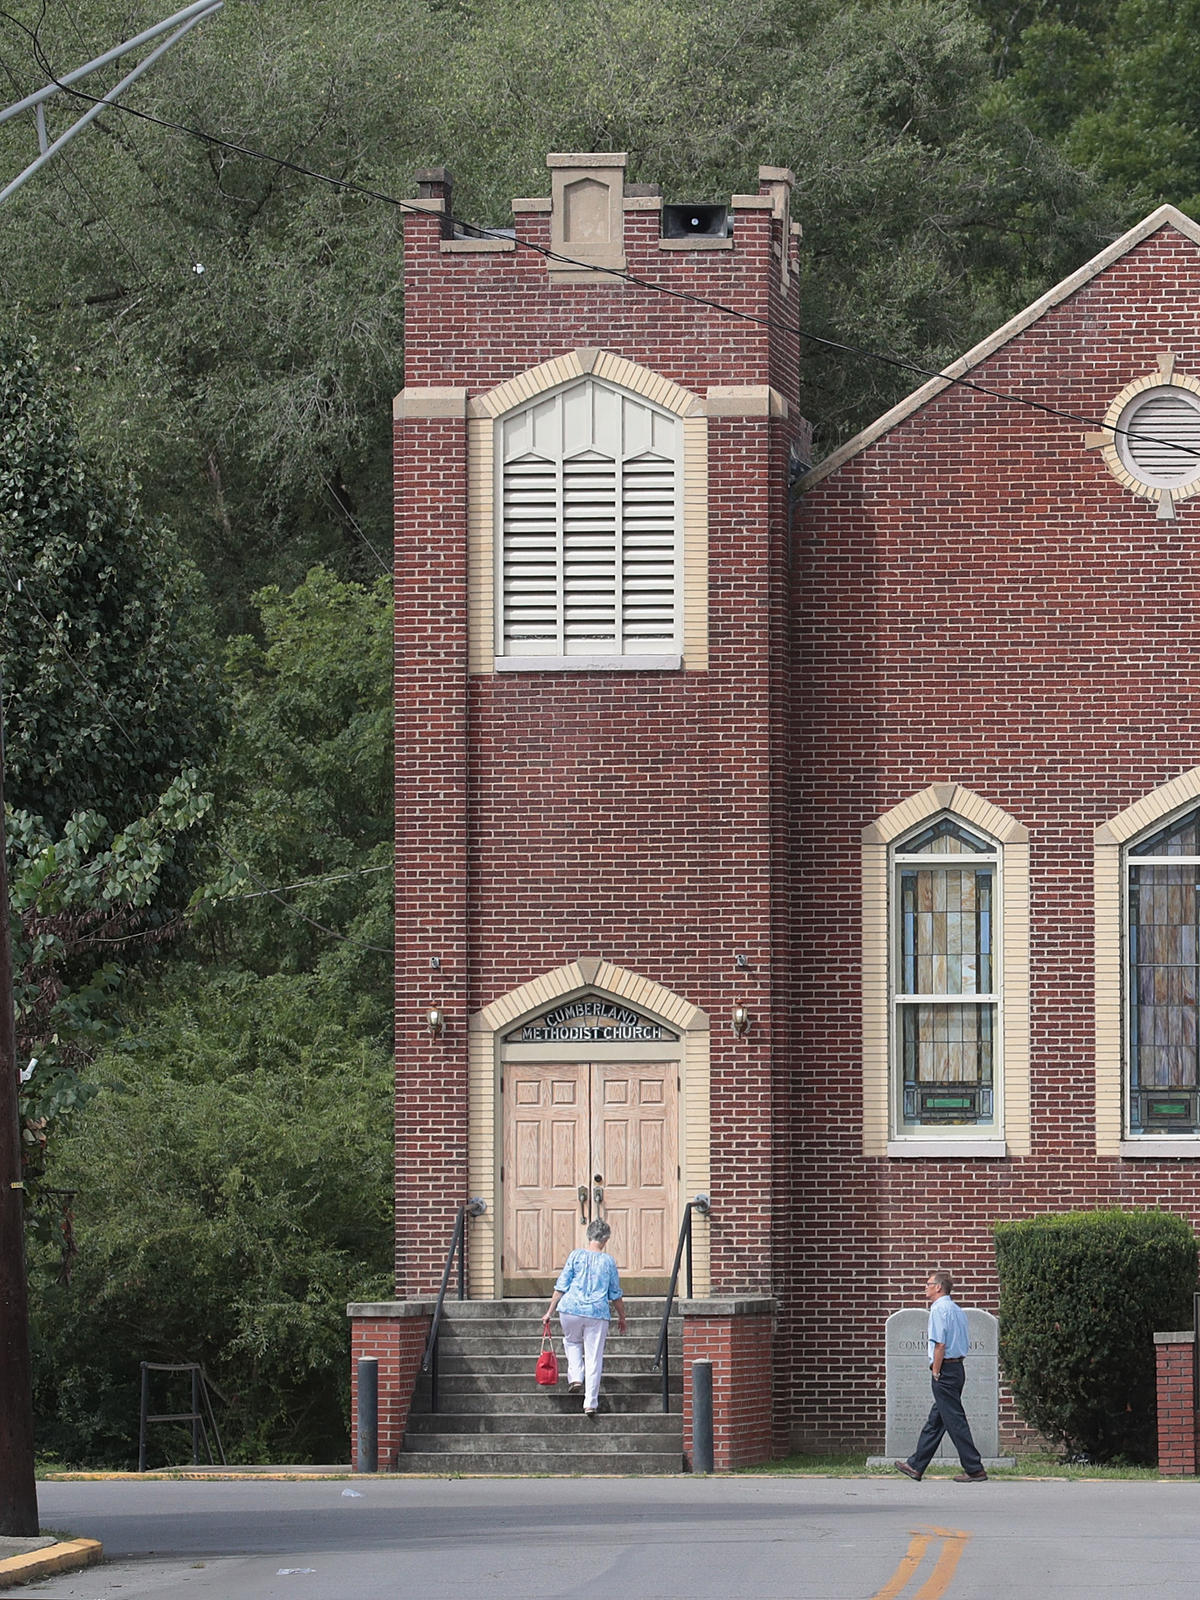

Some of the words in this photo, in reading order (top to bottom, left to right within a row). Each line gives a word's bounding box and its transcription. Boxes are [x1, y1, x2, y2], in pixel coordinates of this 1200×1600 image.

[546, 1003, 638, 1026] CUMBERLAND
[522, 1027, 600, 1040] METHODIST
[603, 1027, 661, 1039] CHURCH
[899, 1341, 985, 1350] COMMNTS
